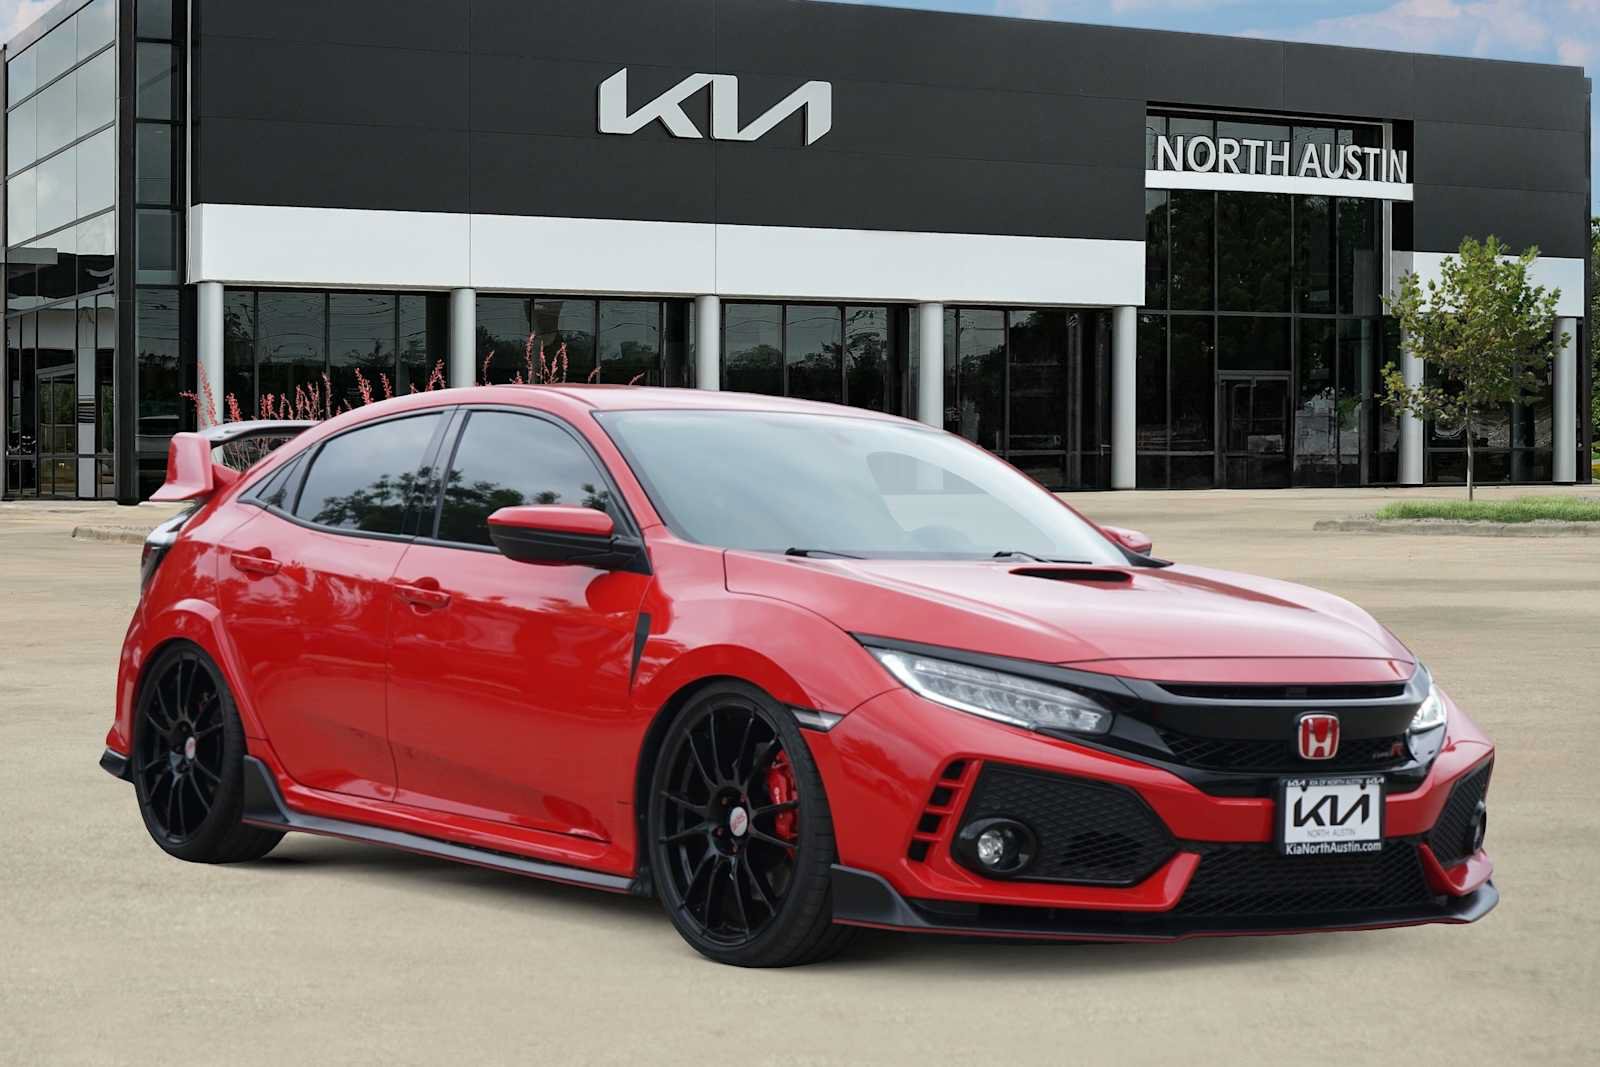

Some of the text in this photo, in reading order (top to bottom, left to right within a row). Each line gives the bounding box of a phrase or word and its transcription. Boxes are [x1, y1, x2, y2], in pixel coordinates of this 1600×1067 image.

[598, 67, 832, 146] KIA
[1156, 134, 1409, 184] NORTH AUSTIN
[1293, 794, 1370, 827] KIA
[1286, 841, 1382, 855] KiaNorthAustin.com
